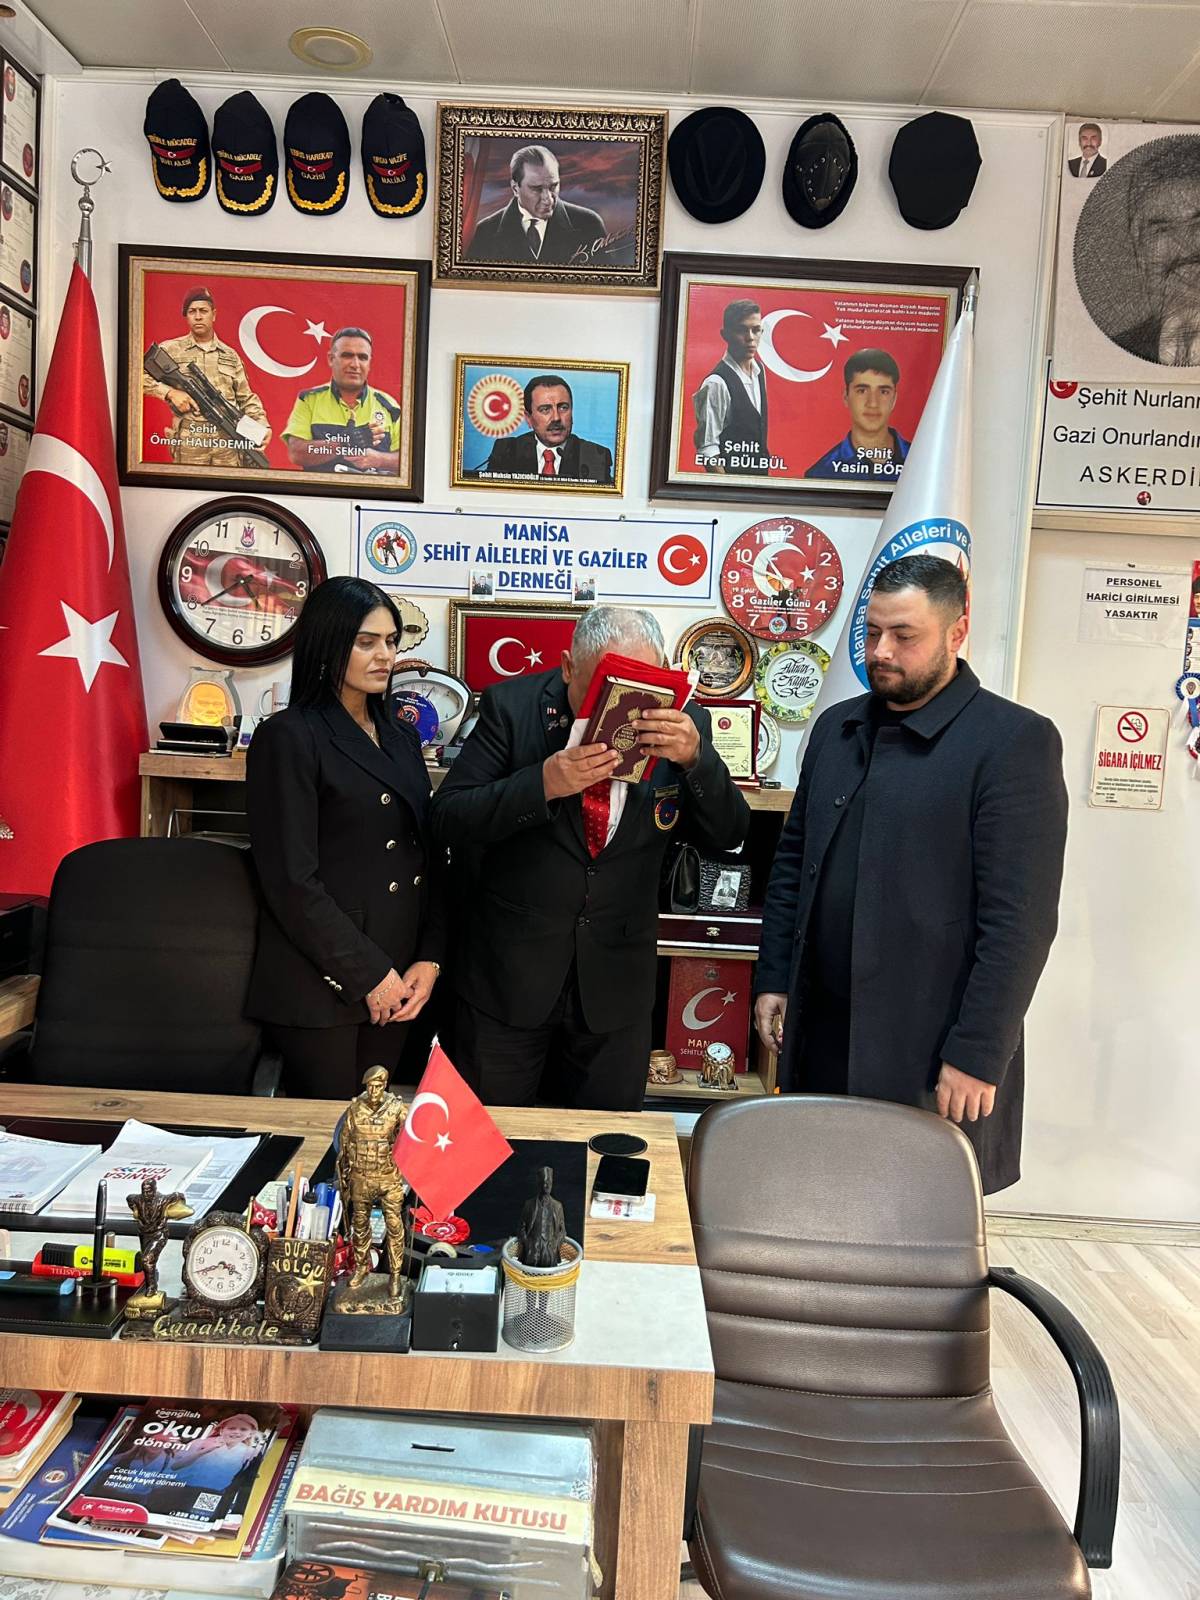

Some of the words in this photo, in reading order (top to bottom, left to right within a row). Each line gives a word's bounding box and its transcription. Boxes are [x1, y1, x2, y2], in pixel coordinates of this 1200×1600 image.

[1077, 387, 1128, 409] Şehit
[150, 433, 182, 447] Ömer
[325, 432, 351, 445] Şehit
[1053, 425, 1096, 444] Gazi
[308, 445, 333, 456] Fethi
[724, 440, 760, 454] Şehit
[857, 447, 893, 461] Şehit
[695, 454, 728, 468] Eren
[731, 455, 788, 470] BÜLBÜL
[832, 461, 868, 475] Yasin
[1079, 465, 1200, 487] ASKERDİ
[215, 521, 229, 539] 11
[504, 521, 570, 543] MANİSA
[273, 529, 280, 546] 1
[807, 532, 813, 546] 1
[193, 539, 210, 557] 10
[424, 541, 471, 562] ŞEHİT
[475, 543, 548, 566] AİLELERİ
[553, 549, 573, 566] VE
[578, 548, 648, 569] GAZİLER
[735, 548, 752, 563] 10
[819, 552, 832, 566] 2
[181, 566, 193, 583] 9
[498, 568, 572, 590] DERNEĞİ
[727, 570, 740, 584] 9
[295, 581, 307, 598] 3
[824, 576, 838, 590] 3
[1106, 577, 1163, 588] PERSONEL
[732, 594, 744, 608] 8
[749, 596, 782, 606] Gaziler
[785, 597, 811, 608] Günü
[853, 605, 866, 667] Manisa
[889, 523, 952, 558] Aileleri
[956, 529, 968, 548] ve
[1086, 592, 1123, 602] HARİCİ
[1125, 593, 1180, 605] GİRİLMESİ
[814, 599, 827, 614] 4
[284, 606, 297, 623] 4
[748, 613, 760, 627] 7
[1105, 609, 1158, 620] YASAKTIR
[205, 618, 217, 634] 7
[796, 617, 808, 631] 5
[232, 628, 243, 645] 6
[260, 624, 272, 641] 5
[1098, 748, 1128, 769] SİGARA
[1129, 750, 1162, 773] İÇİLMEZ
[688, 1039, 713, 1049] MAN
[222, 1238, 230, 1246] 12
[203, 1247, 213, 1255] 10
[240, 1252, 246, 1260] 2
[285, 1241, 309, 1259] DUR
[271, 1258, 326, 1279] YOLCU
[207, 1276, 214, 1285] 7
[216, 1281, 224, 1290] 6
[228, 1280, 235, 1288] 5
[143, 1419, 213, 1441] okul
[133, 1436, 193, 1451] dönemi
[155, 1479, 187, 1488] dönemi
[295, 1483, 367, 1508] BAĞIŞ
[372, 1491, 468, 1519] YARDIM
[472, 1503, 568, 1532] KUTUSU
